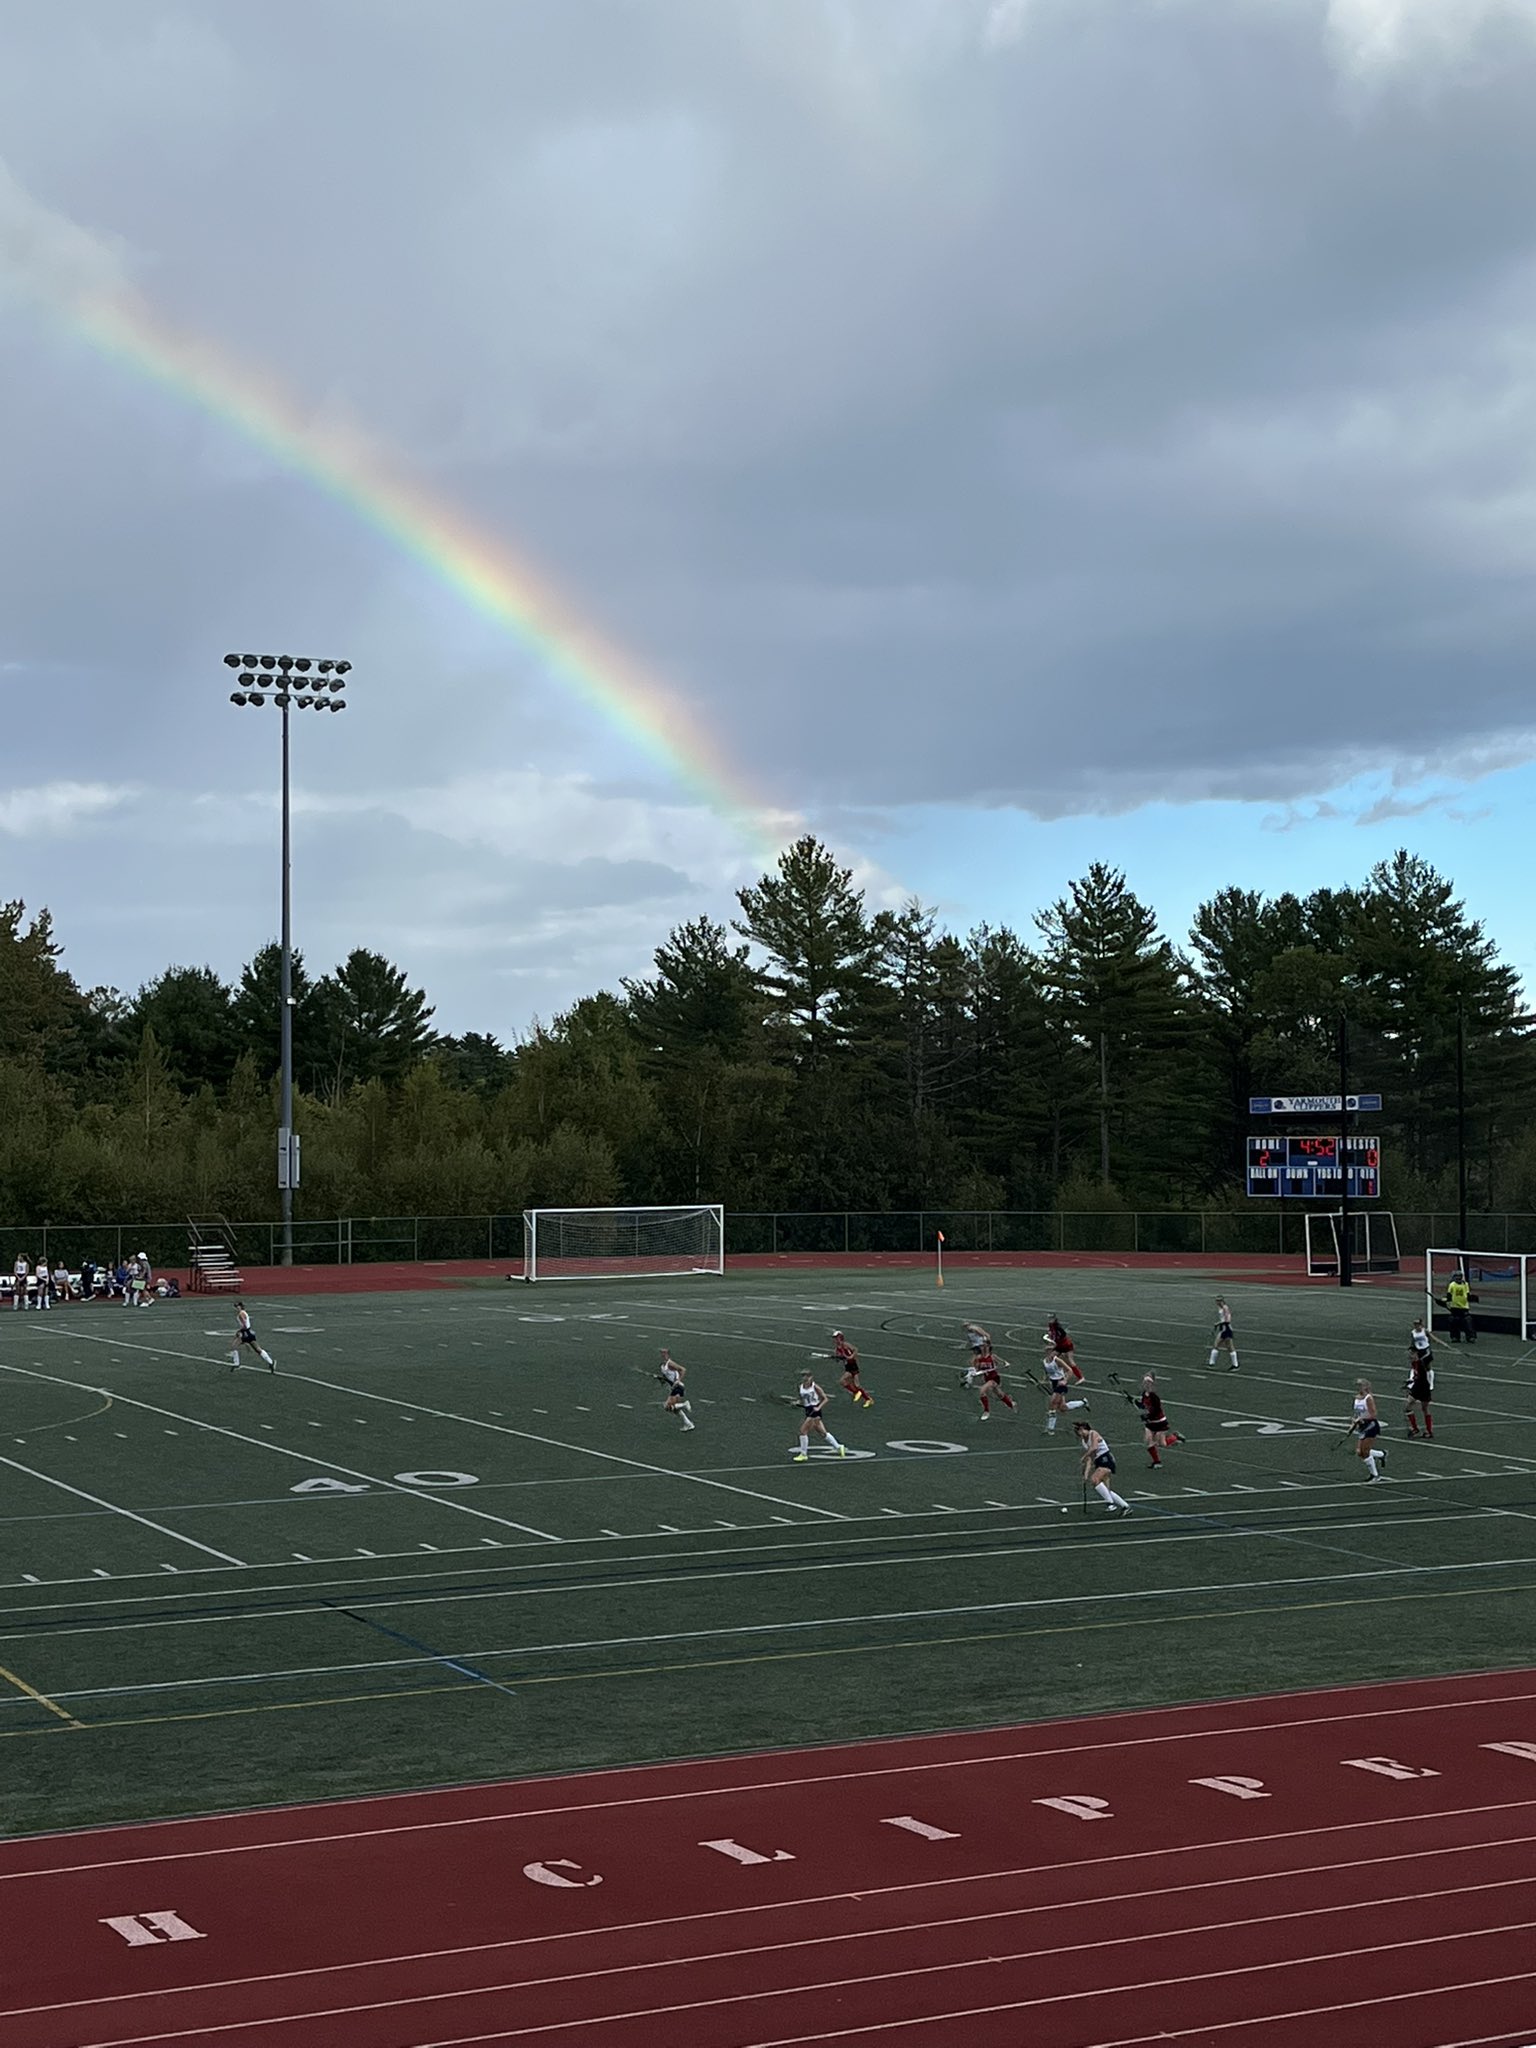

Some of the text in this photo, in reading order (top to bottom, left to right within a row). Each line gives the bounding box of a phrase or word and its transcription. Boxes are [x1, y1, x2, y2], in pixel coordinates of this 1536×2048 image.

[1288, 1097, 1341, 1105] YARMOUTH
[1255, 1139, 1279, 1149] HOME
[1301, 1137, 1334, 1155] 4:52
[1340, 1139, 1375, 1149] UESTS
[1260, 1150, 1269, 1167] 2
[1367, 1149, 1377, 1167] 0
[788, 1439, 969, 1460] 30
[289, 1470, 481, 1493] 40
